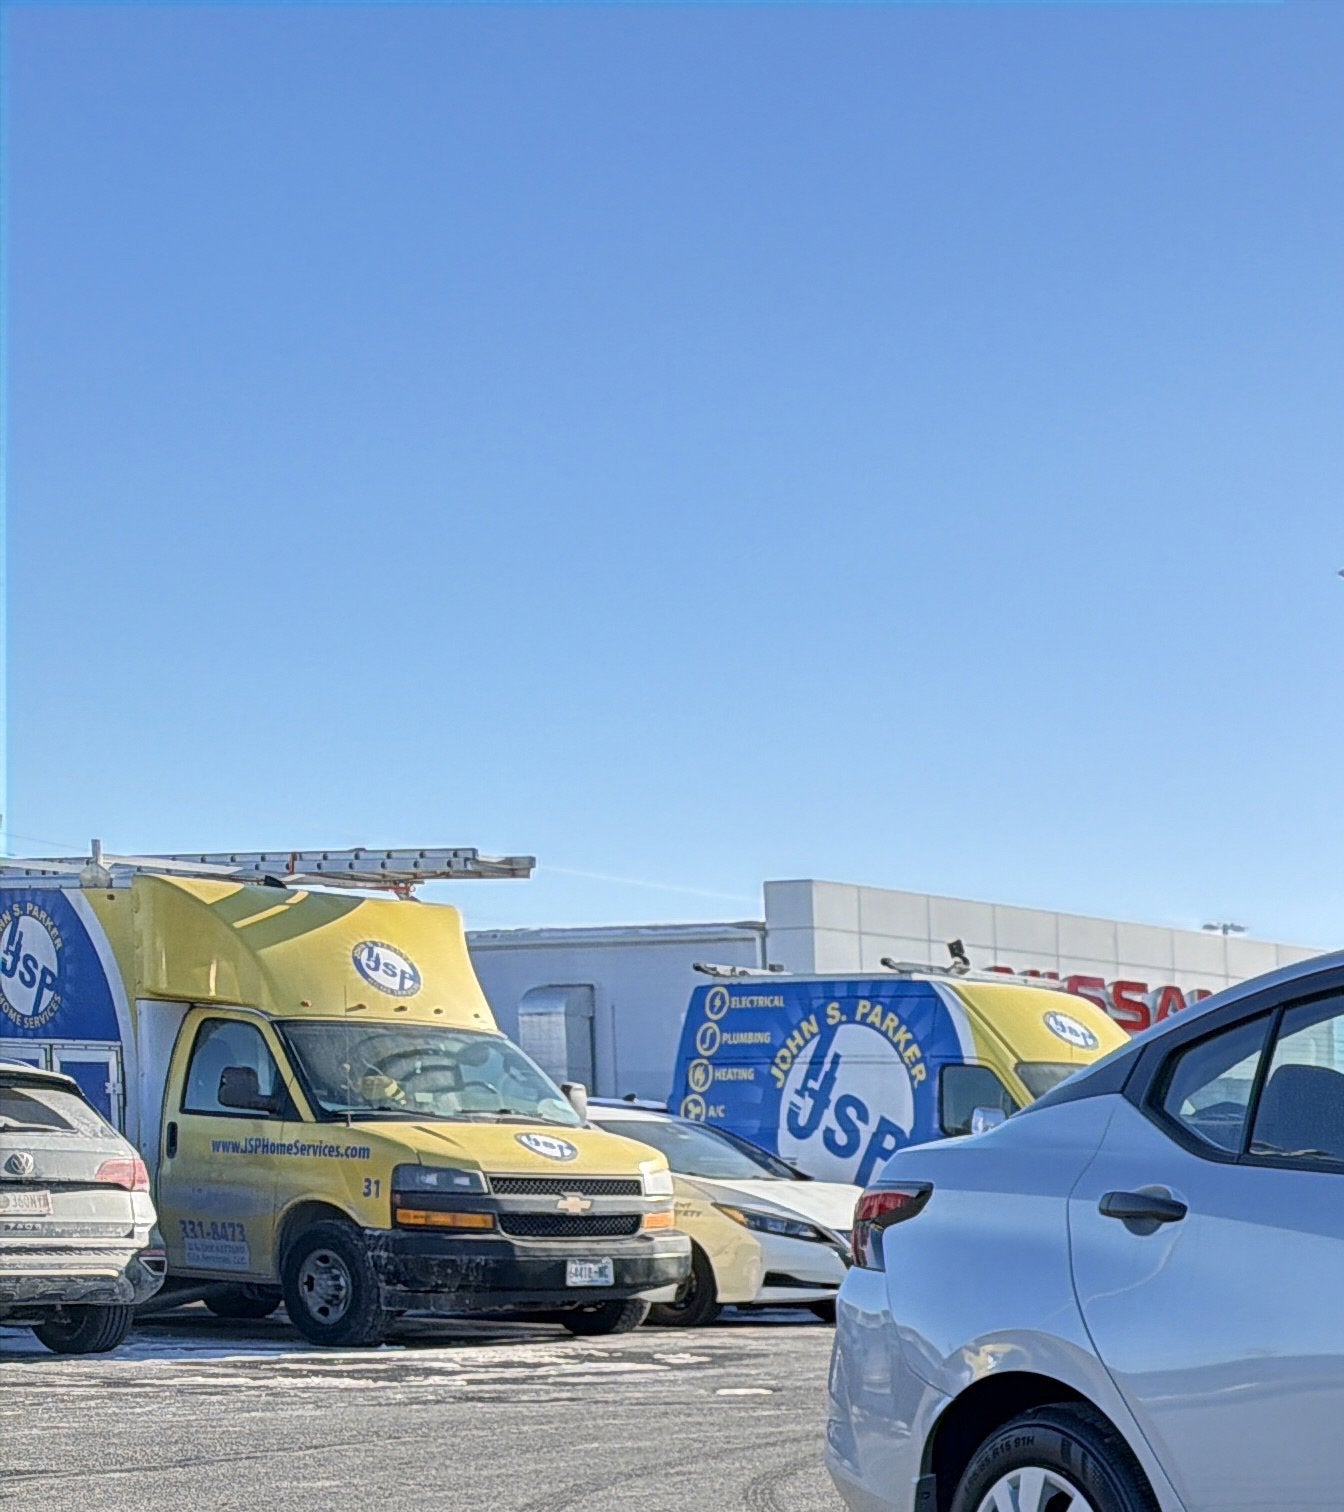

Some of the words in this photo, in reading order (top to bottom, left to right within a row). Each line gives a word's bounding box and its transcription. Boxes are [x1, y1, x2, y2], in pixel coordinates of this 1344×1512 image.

[26, 902, 62, 950] PARKER
[23, 995, 62, 1030] SERVICES
[729, 996, 785, 1008] ELECTRICAL
[722, 1032, 771, 1044] PLUMBING
[770, 1013, 821, 1089] JOHN
[826, 1002, 847, 1026] S.
[855, 999, 927, 1089] PARKER
[714, 1068, 755, 1080] HEATING
[708, 1105, 725, 1117] A/C
[211, 1137, 371, 1159] www.JSPHomeServices.com
[362, 1177, 381, 1198] 31
[179, 1219, 247, 1242] 331-8473
